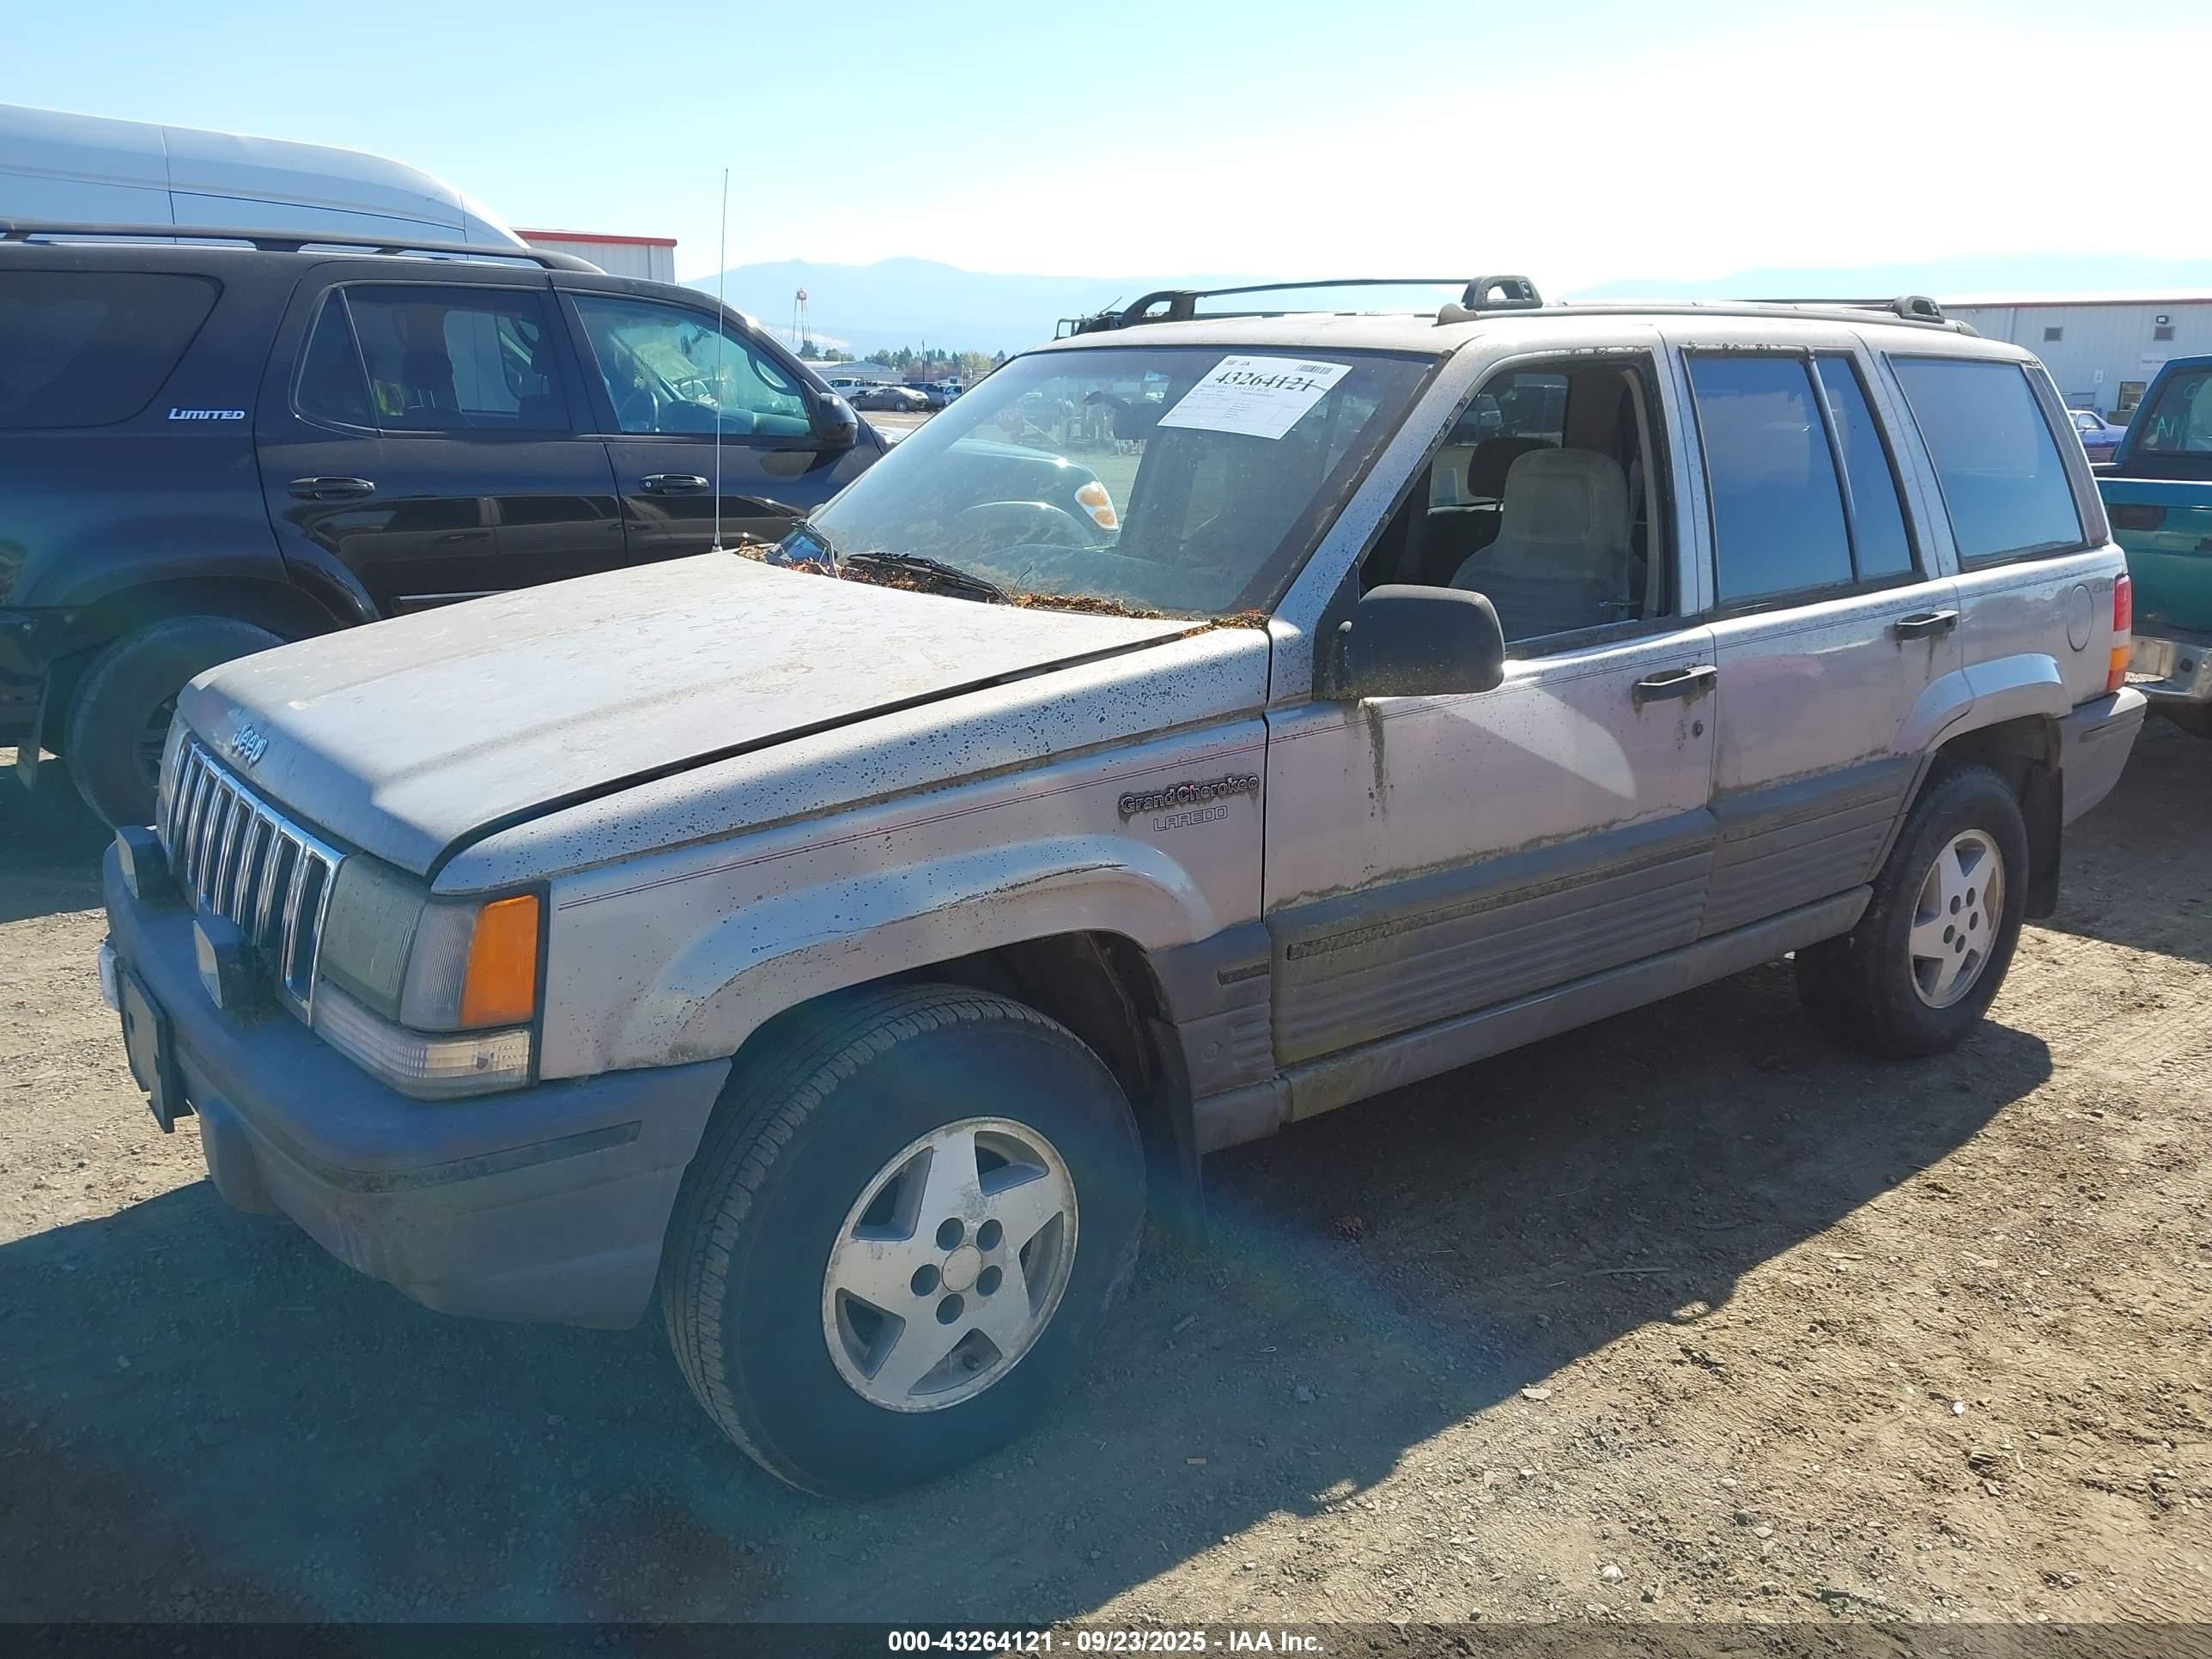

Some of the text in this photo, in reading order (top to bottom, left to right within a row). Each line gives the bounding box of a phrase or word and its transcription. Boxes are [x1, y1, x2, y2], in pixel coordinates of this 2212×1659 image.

[1215, 371, 1316, 392] 43264121
[168, 408, 246, 420] LIMITED
[232, 723, 267, 765] Jeep
[1153, 805, 1229, 832] LAREDO
